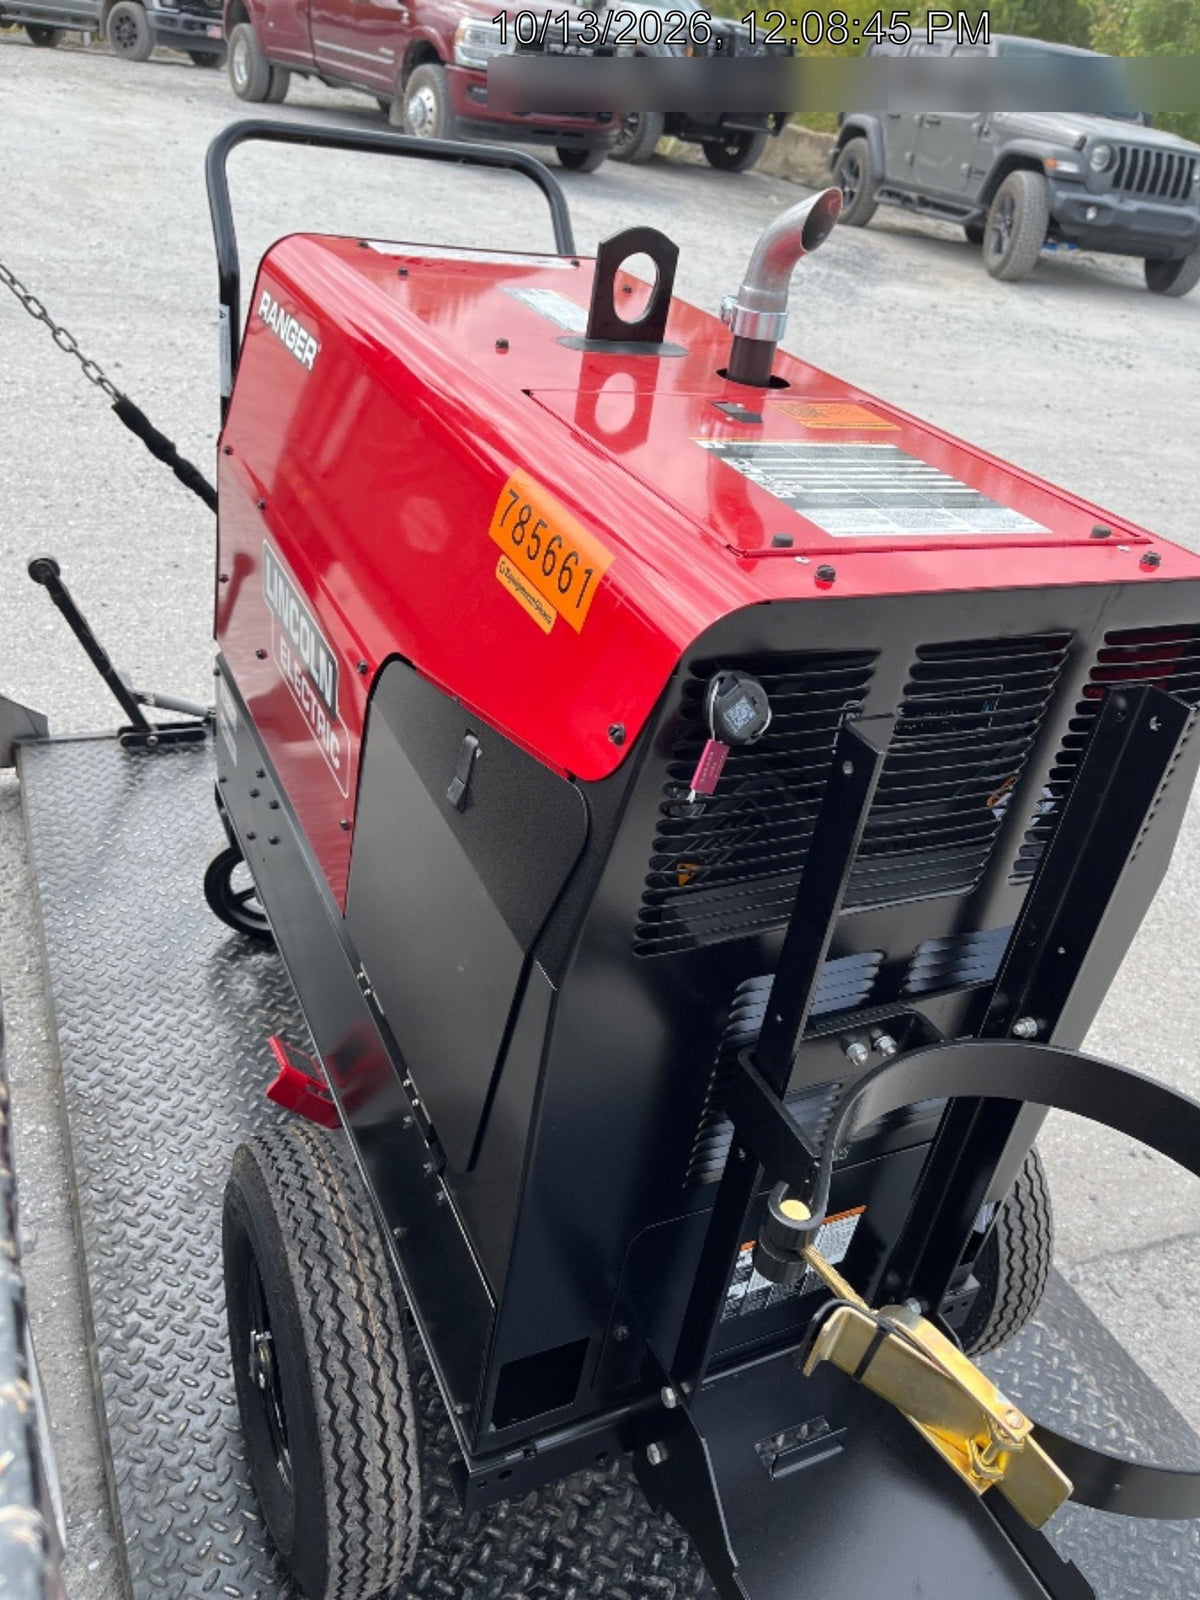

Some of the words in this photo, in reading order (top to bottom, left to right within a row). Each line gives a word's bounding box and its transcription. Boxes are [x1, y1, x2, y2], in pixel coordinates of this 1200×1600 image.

[258, 289, 319, 371] RANGER
[499, 488, 594, 609] 785661
[264, 556, 334, 707] LINCOLN
[279, 634, 341, 770] ELECTRIC
